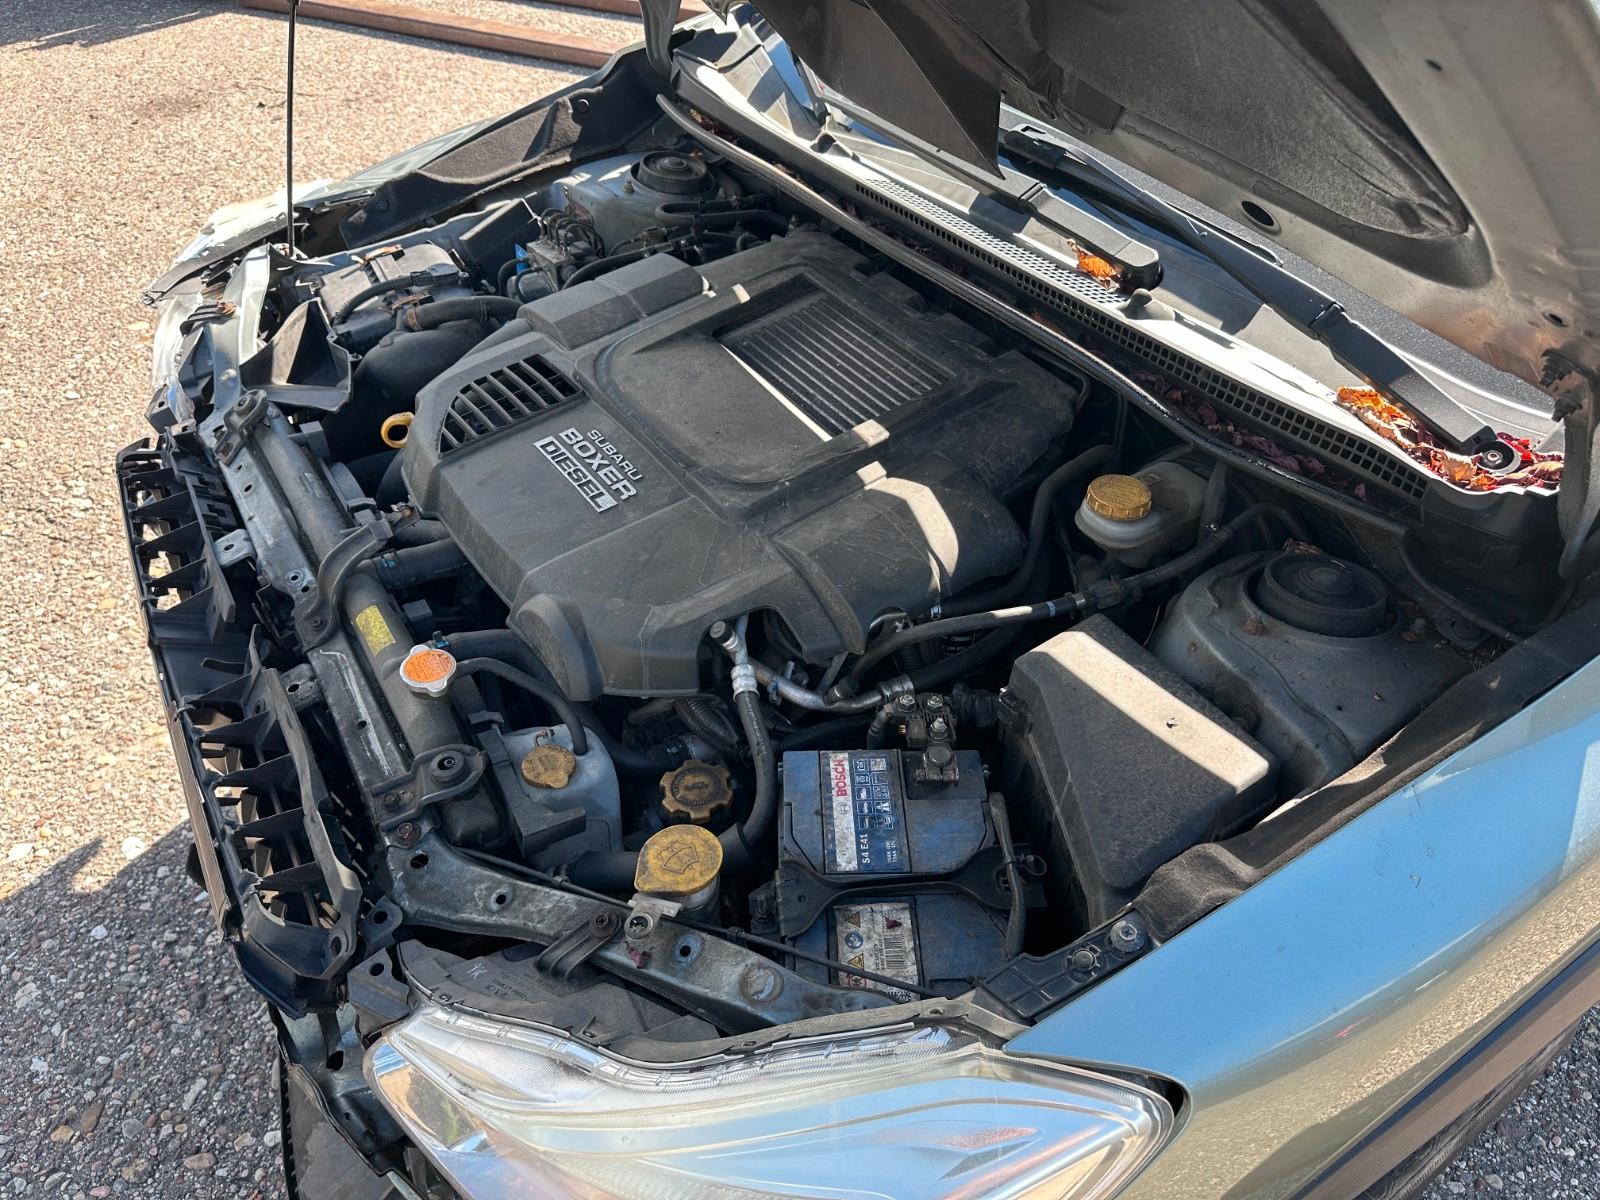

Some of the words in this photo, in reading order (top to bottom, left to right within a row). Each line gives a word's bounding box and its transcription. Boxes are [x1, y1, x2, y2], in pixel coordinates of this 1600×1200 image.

[536, 438, 611, 511] DIESEL
[558, 427, 637, 500] BOXER
[587, 429, 643, 481] SUBARU
[833, 758, 848, 797] BOSCH
[860, 833, 869, 849] E41
[861, 852, 871, 864] S4
